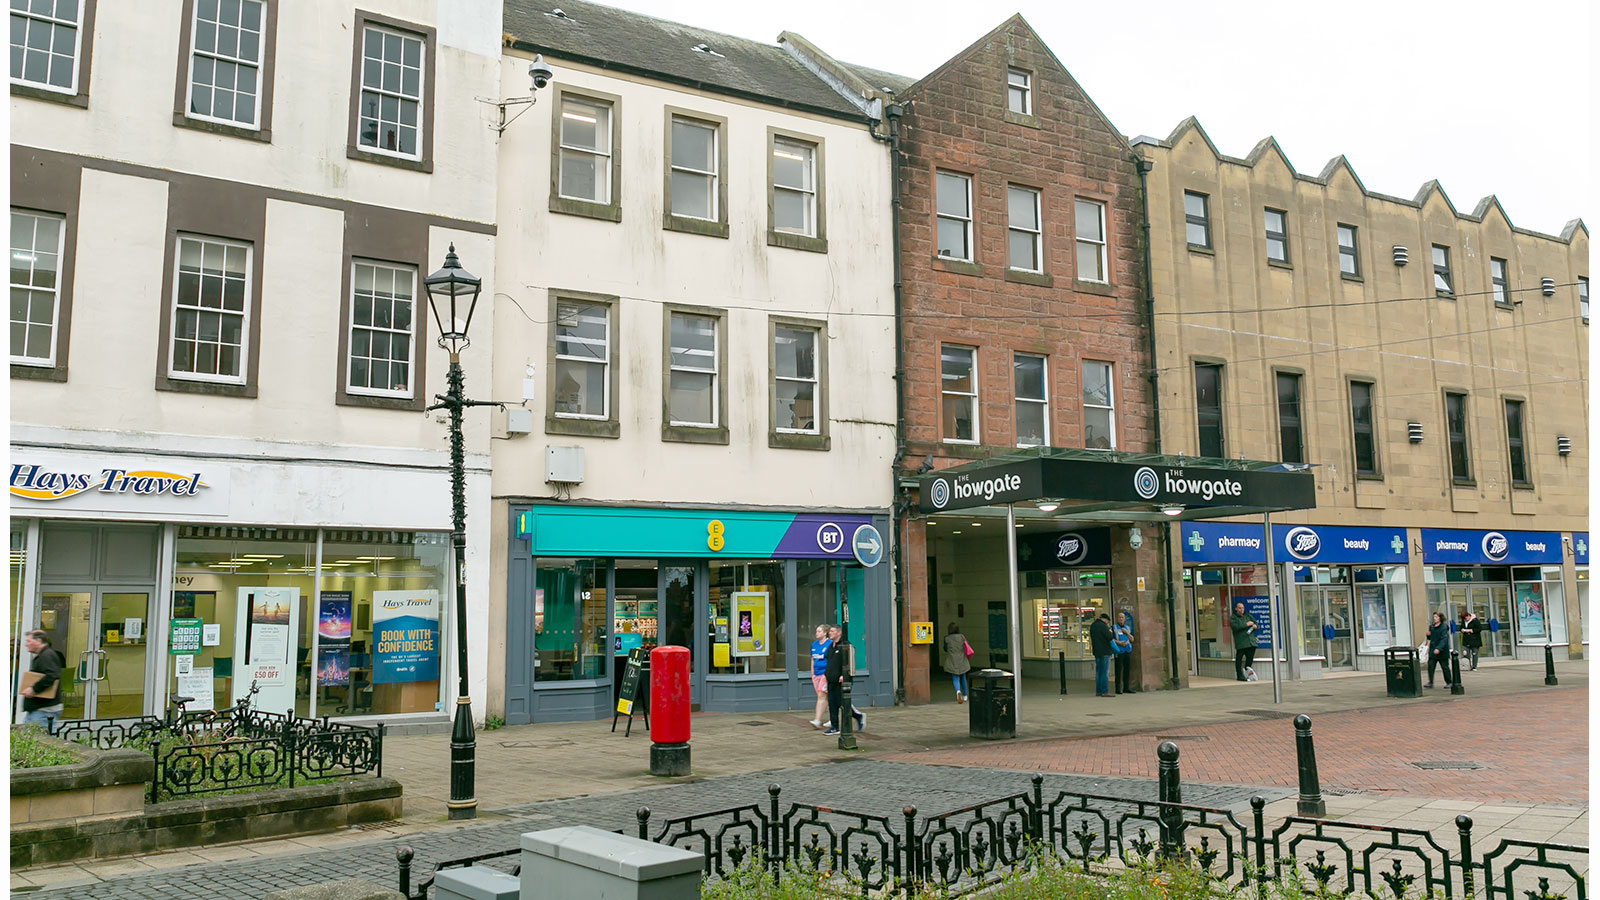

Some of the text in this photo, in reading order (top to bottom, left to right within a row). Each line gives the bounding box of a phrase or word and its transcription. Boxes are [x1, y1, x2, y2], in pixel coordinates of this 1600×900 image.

[10, 464, 201, 495] Hays Travel
[958, 474, 969, 482] THE
[954, 474, 1021, 500] howgate
[1165, 472, 1242, 500] howgate
[823, 532, 838, 544] BT
[1218, 536, 1260, 549] pharmacy
[1294, 534, 1318, 551] Boots
[1343, 538, 1369, 550] beauty
[1057, 539, 1079, 557] Boots
[1436, 540, 1468, 552] pharmacy
[1490, 538, 1507, 554] Boots
[1525, 542, 1546, 552] beauty
[383, 599, 432, 608] Hays Travel
[381, 629, 431, 642] BOOK WITH
[377, 640, 434, 653] CONFIDENCE
